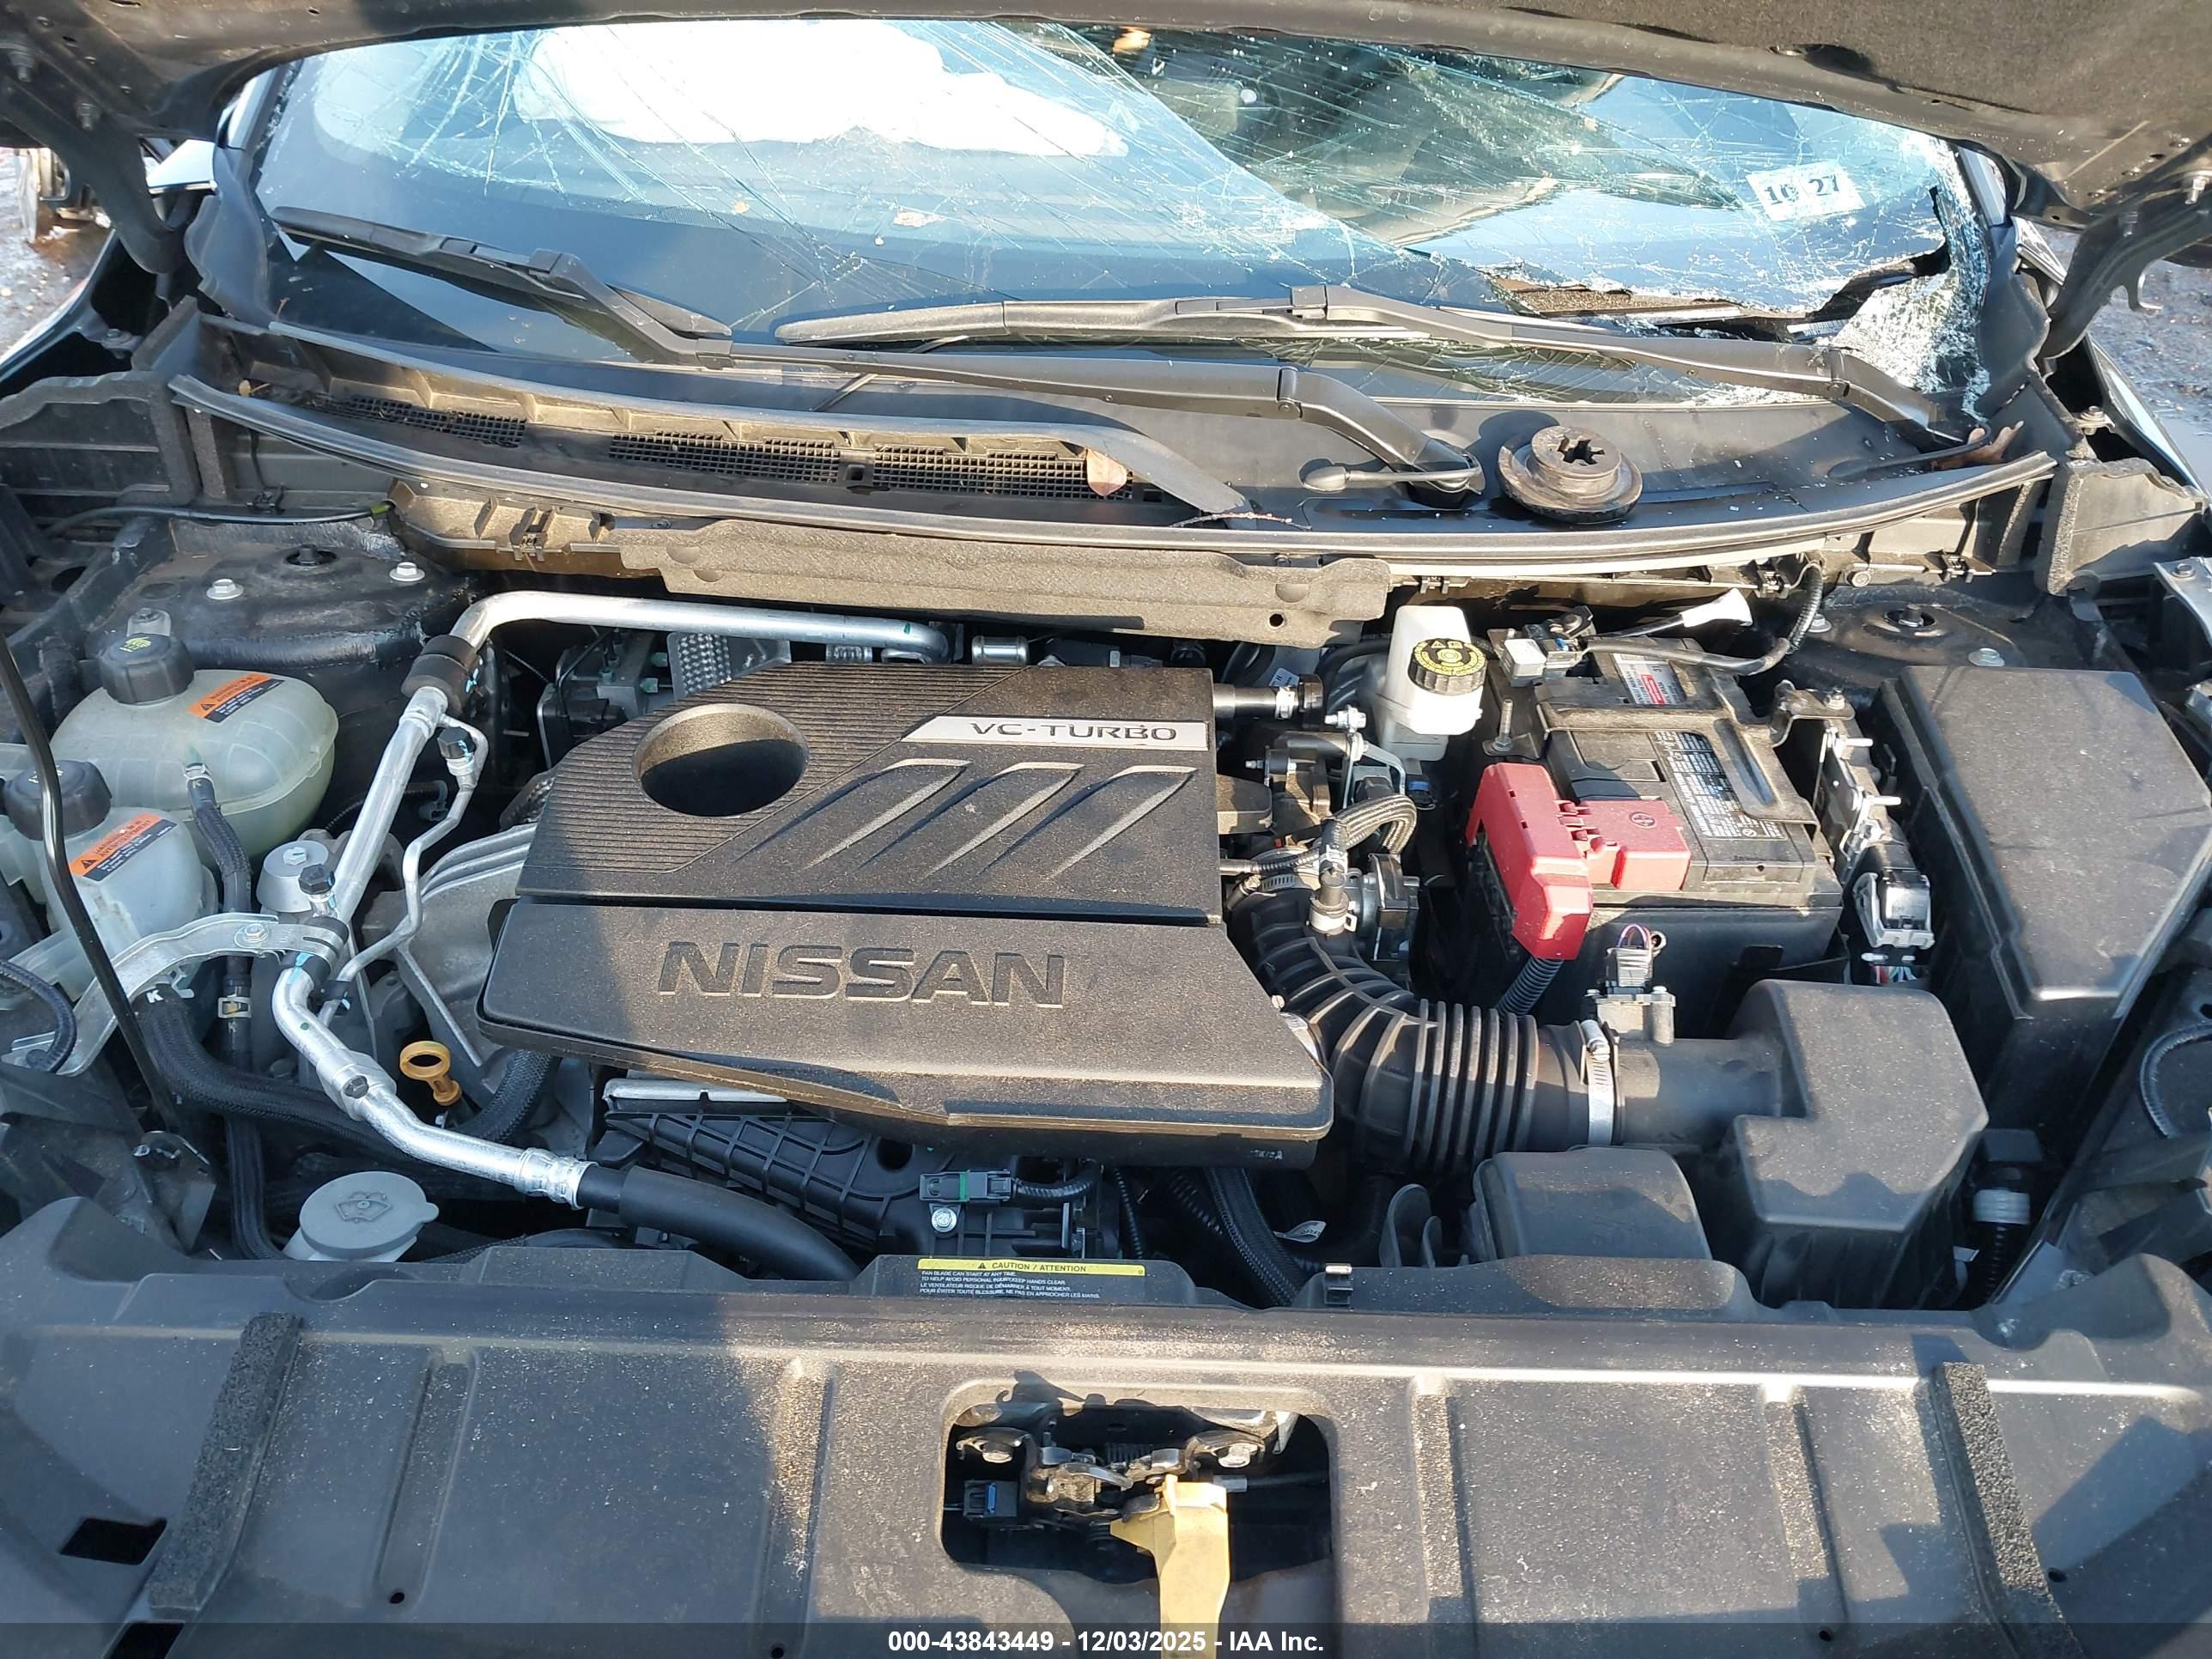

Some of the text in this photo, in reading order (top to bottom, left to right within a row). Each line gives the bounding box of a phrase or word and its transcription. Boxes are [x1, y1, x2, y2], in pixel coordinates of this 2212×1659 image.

[1808, 173, 1839, 196] 27
[969, 721, 1177, 740] VC-TURBO
[658, 941, 1065, 1008] NISSAN
[146, 989, 164, 1003] K
[992, 1261, 1030, 1270] CAUTION
